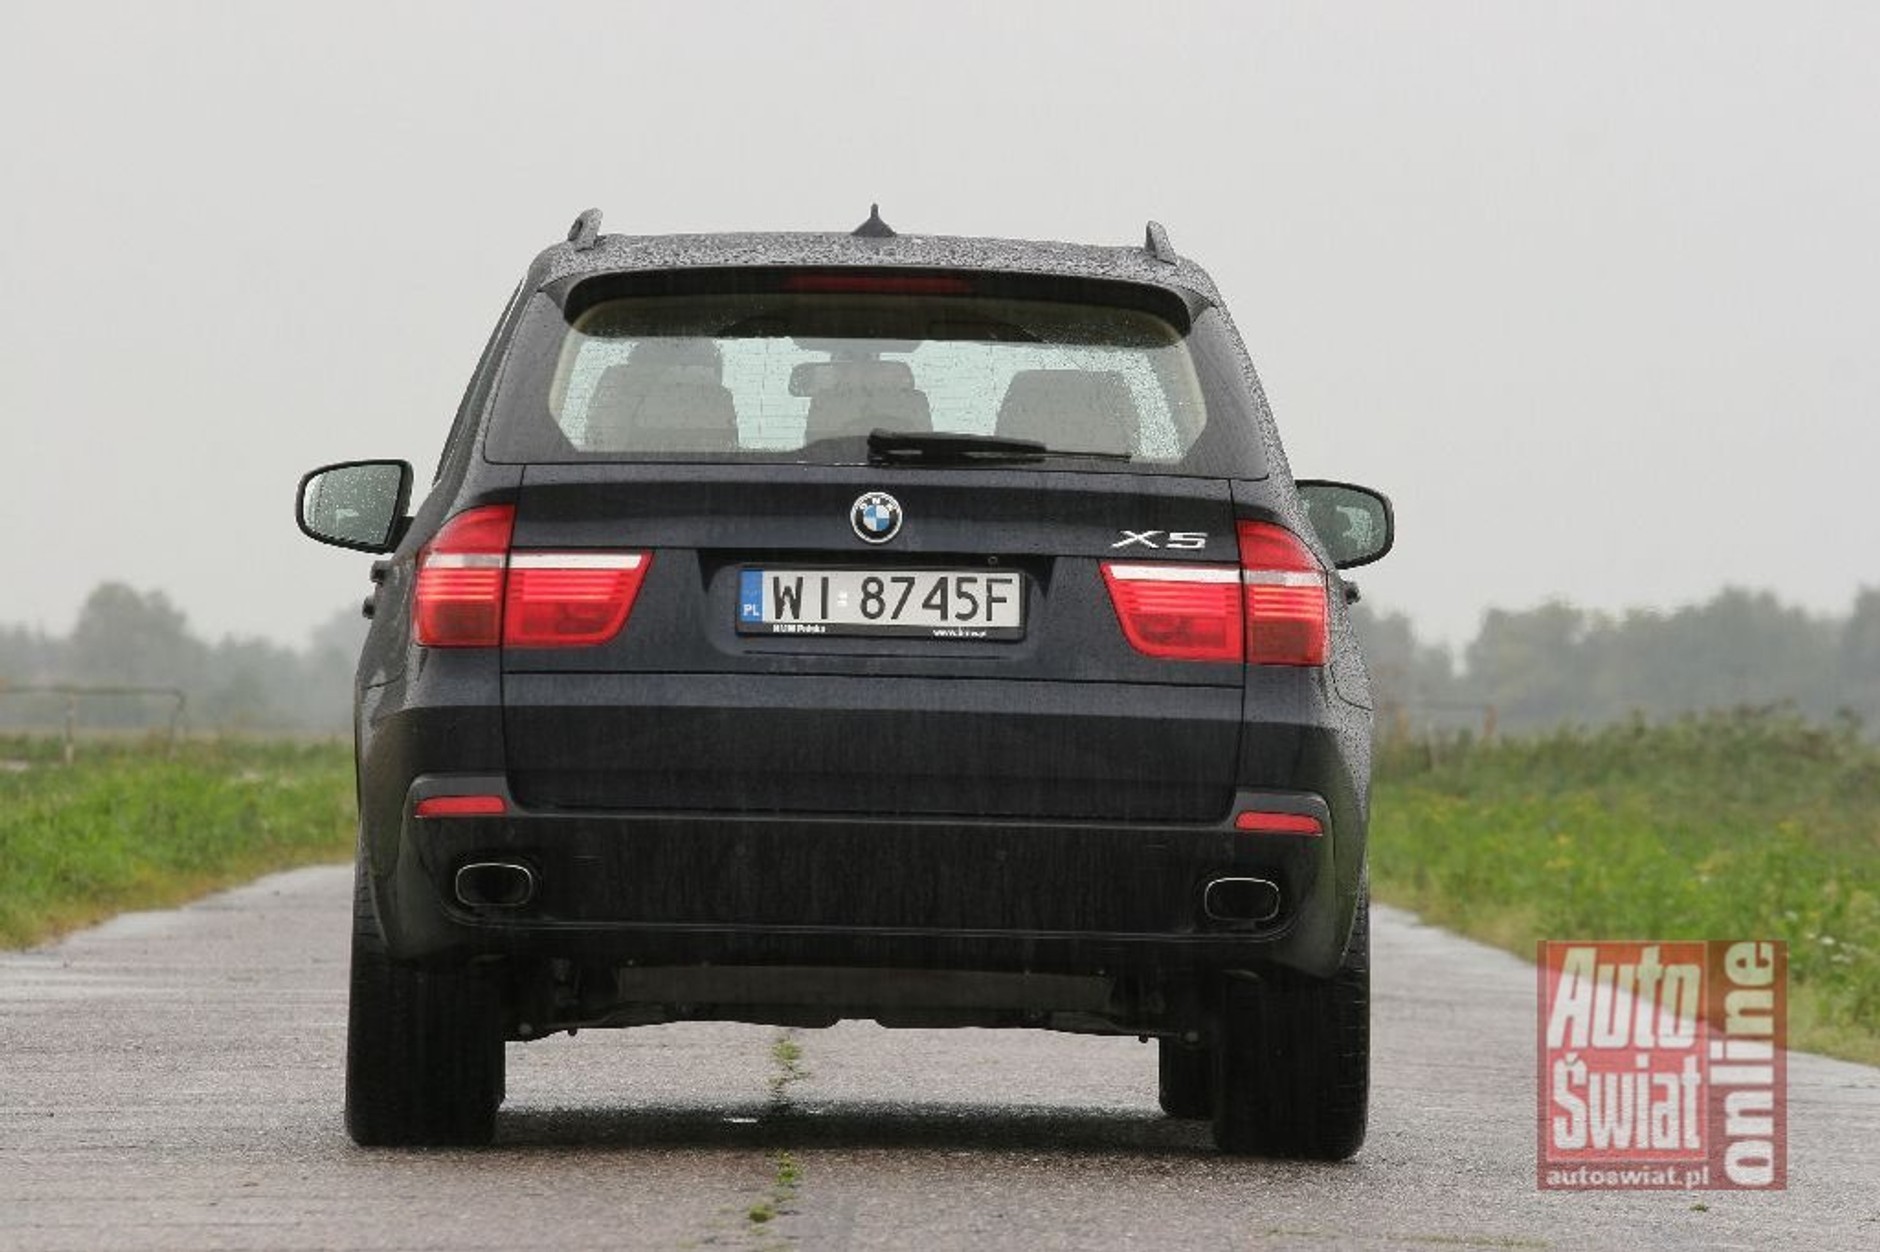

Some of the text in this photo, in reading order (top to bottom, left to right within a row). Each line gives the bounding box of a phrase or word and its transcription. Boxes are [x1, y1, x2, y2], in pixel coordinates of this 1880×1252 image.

[1110, 530, 1208, 549] X5
[860, 576, 1013, 622] 8745F
[743, 604, 760, 617] PL
